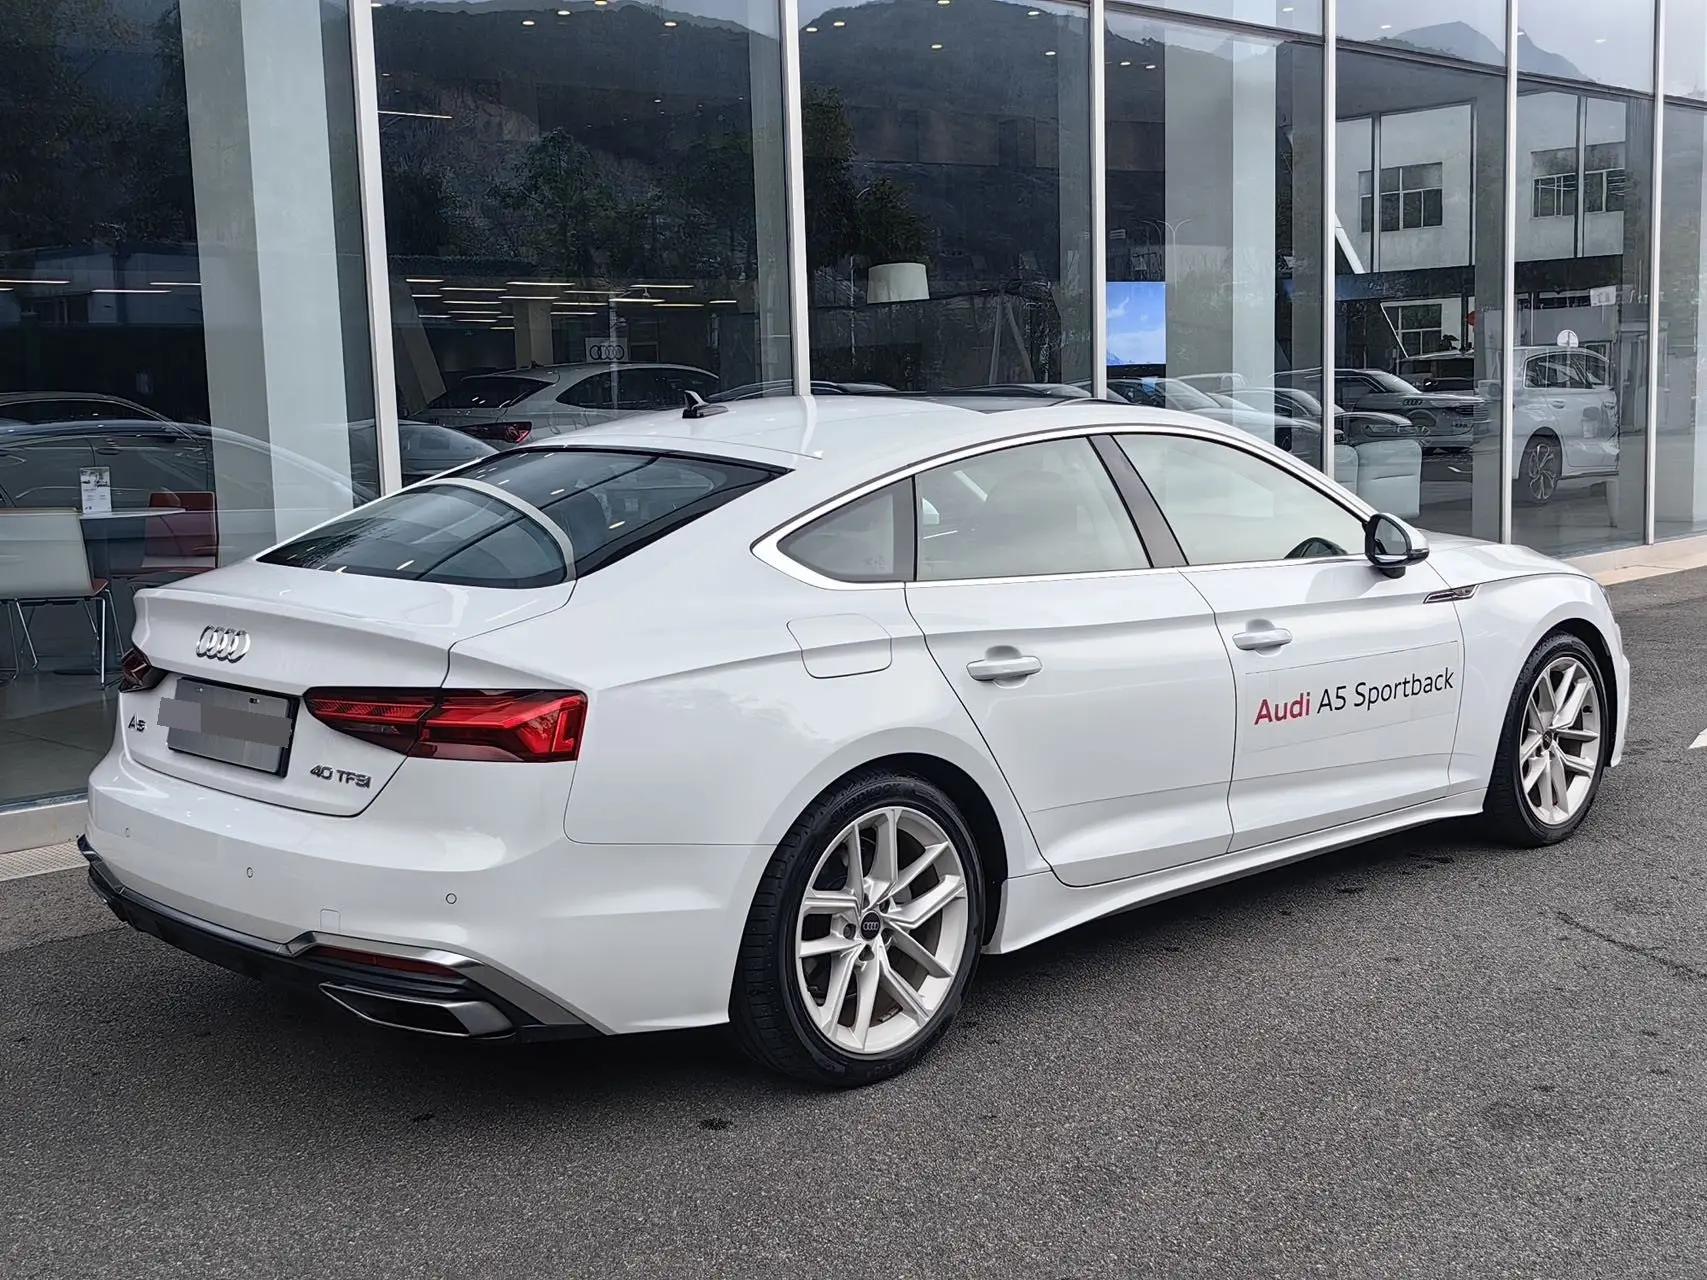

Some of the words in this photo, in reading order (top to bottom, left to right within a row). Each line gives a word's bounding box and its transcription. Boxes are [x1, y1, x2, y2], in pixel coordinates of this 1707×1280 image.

[1254, 691, 1311, 725] Audi
[1317, 685, 1347, 714] A5
[1353, 667, 1454, 711] Sportback
[310, 764, 333, 781] 40
[336, 769, 371, 789] TFSI
